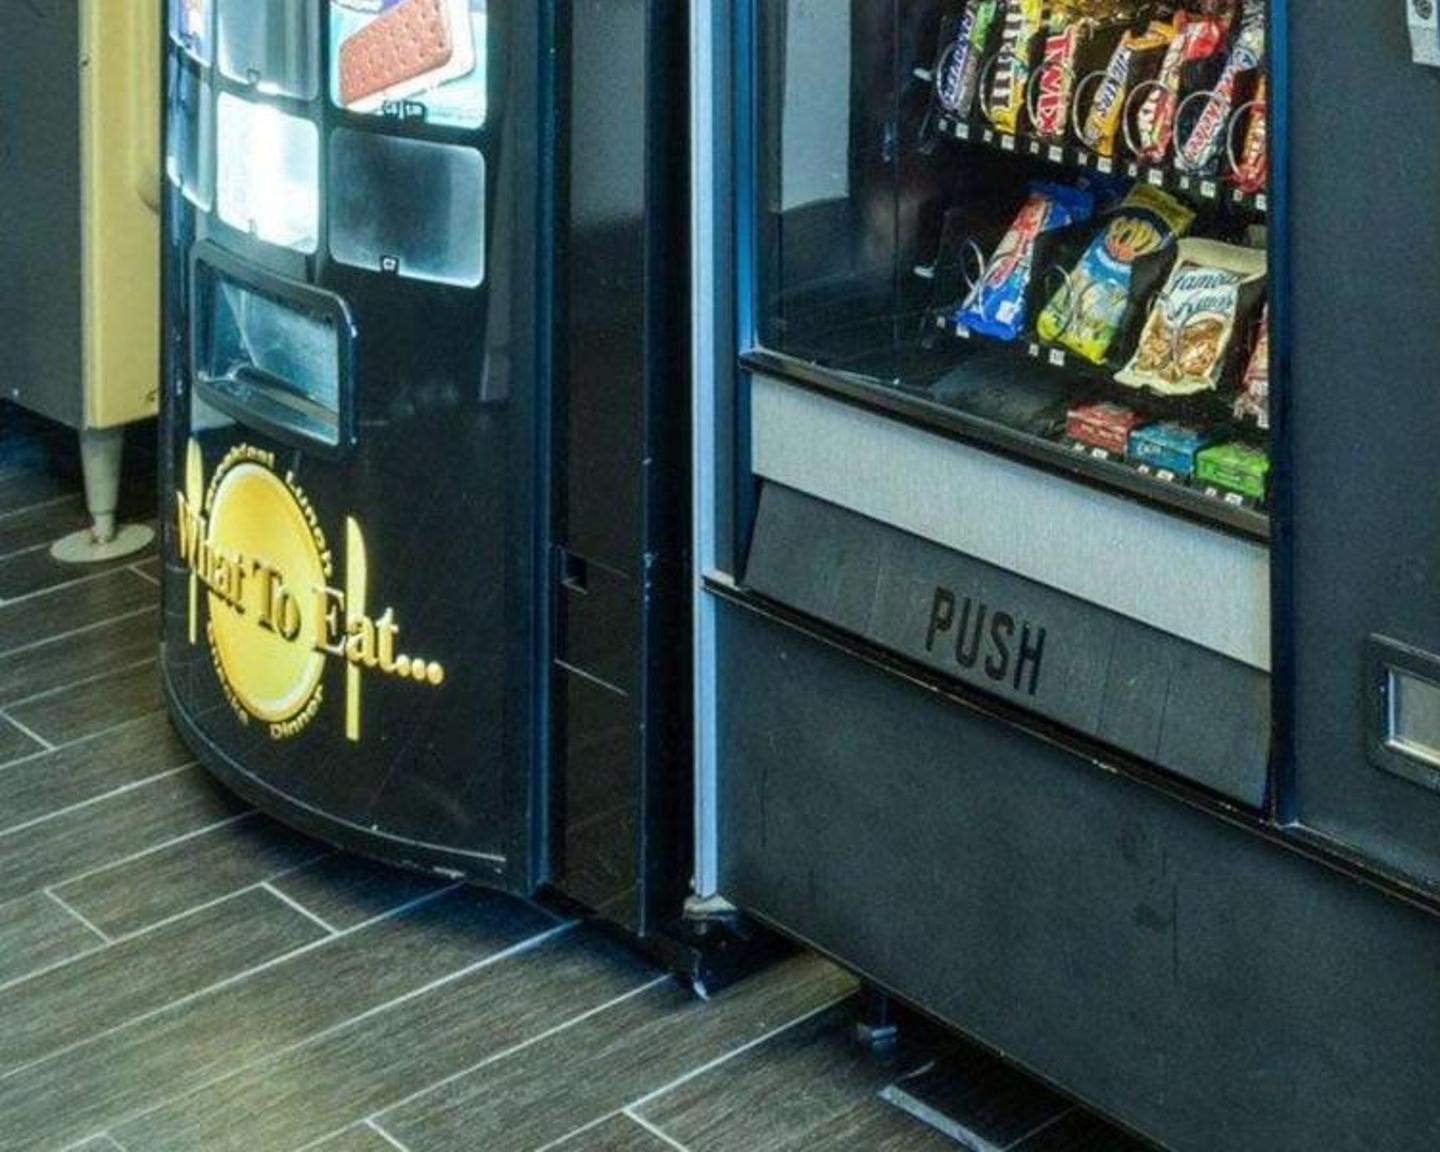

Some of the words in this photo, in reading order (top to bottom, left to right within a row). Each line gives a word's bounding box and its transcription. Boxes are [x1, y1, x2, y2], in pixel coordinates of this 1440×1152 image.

[254, 560, 300, 642] To
[925, 586, 1047, 696] PUSH
[269, 684, 323, 741] Dinner
